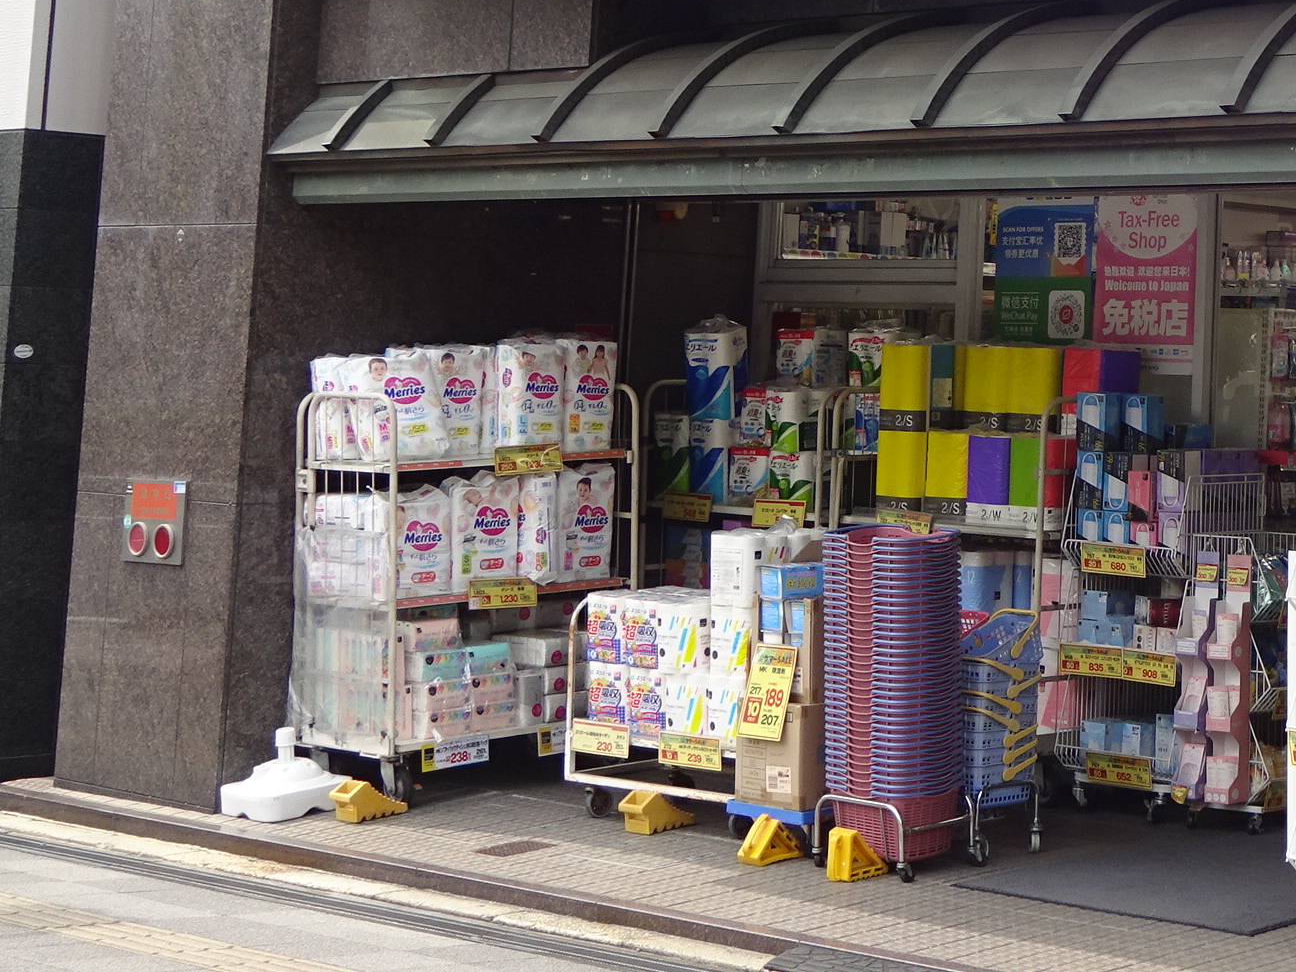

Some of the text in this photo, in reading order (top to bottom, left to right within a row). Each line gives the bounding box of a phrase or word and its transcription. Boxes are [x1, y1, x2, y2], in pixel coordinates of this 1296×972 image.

[1118, 211, 1180, 228] Tax-Free
[1128, 232, 1167, 251] Shop
[1105, 280, 1189, 292] Welcome to Japan
[1103, 298, 1188, 337] 免税店
[385, 385, 425, 398] Merries
[443, 388, 477, 397] Merries
[526, 383, 559, 392] Merries
[577, 384, 609, 395] Merries
[474, 517, 511, 529] Merries
[575, 514, 609, 527] Merries
[404, 531, 442, 544] Merries
[750, 686, 762, 695] 217
[765, 688, 784, 708] 189
[761, 714, 779, 726] 207
[596, 741, 613, 753] 230
[450, 750, 469, 764] 238
